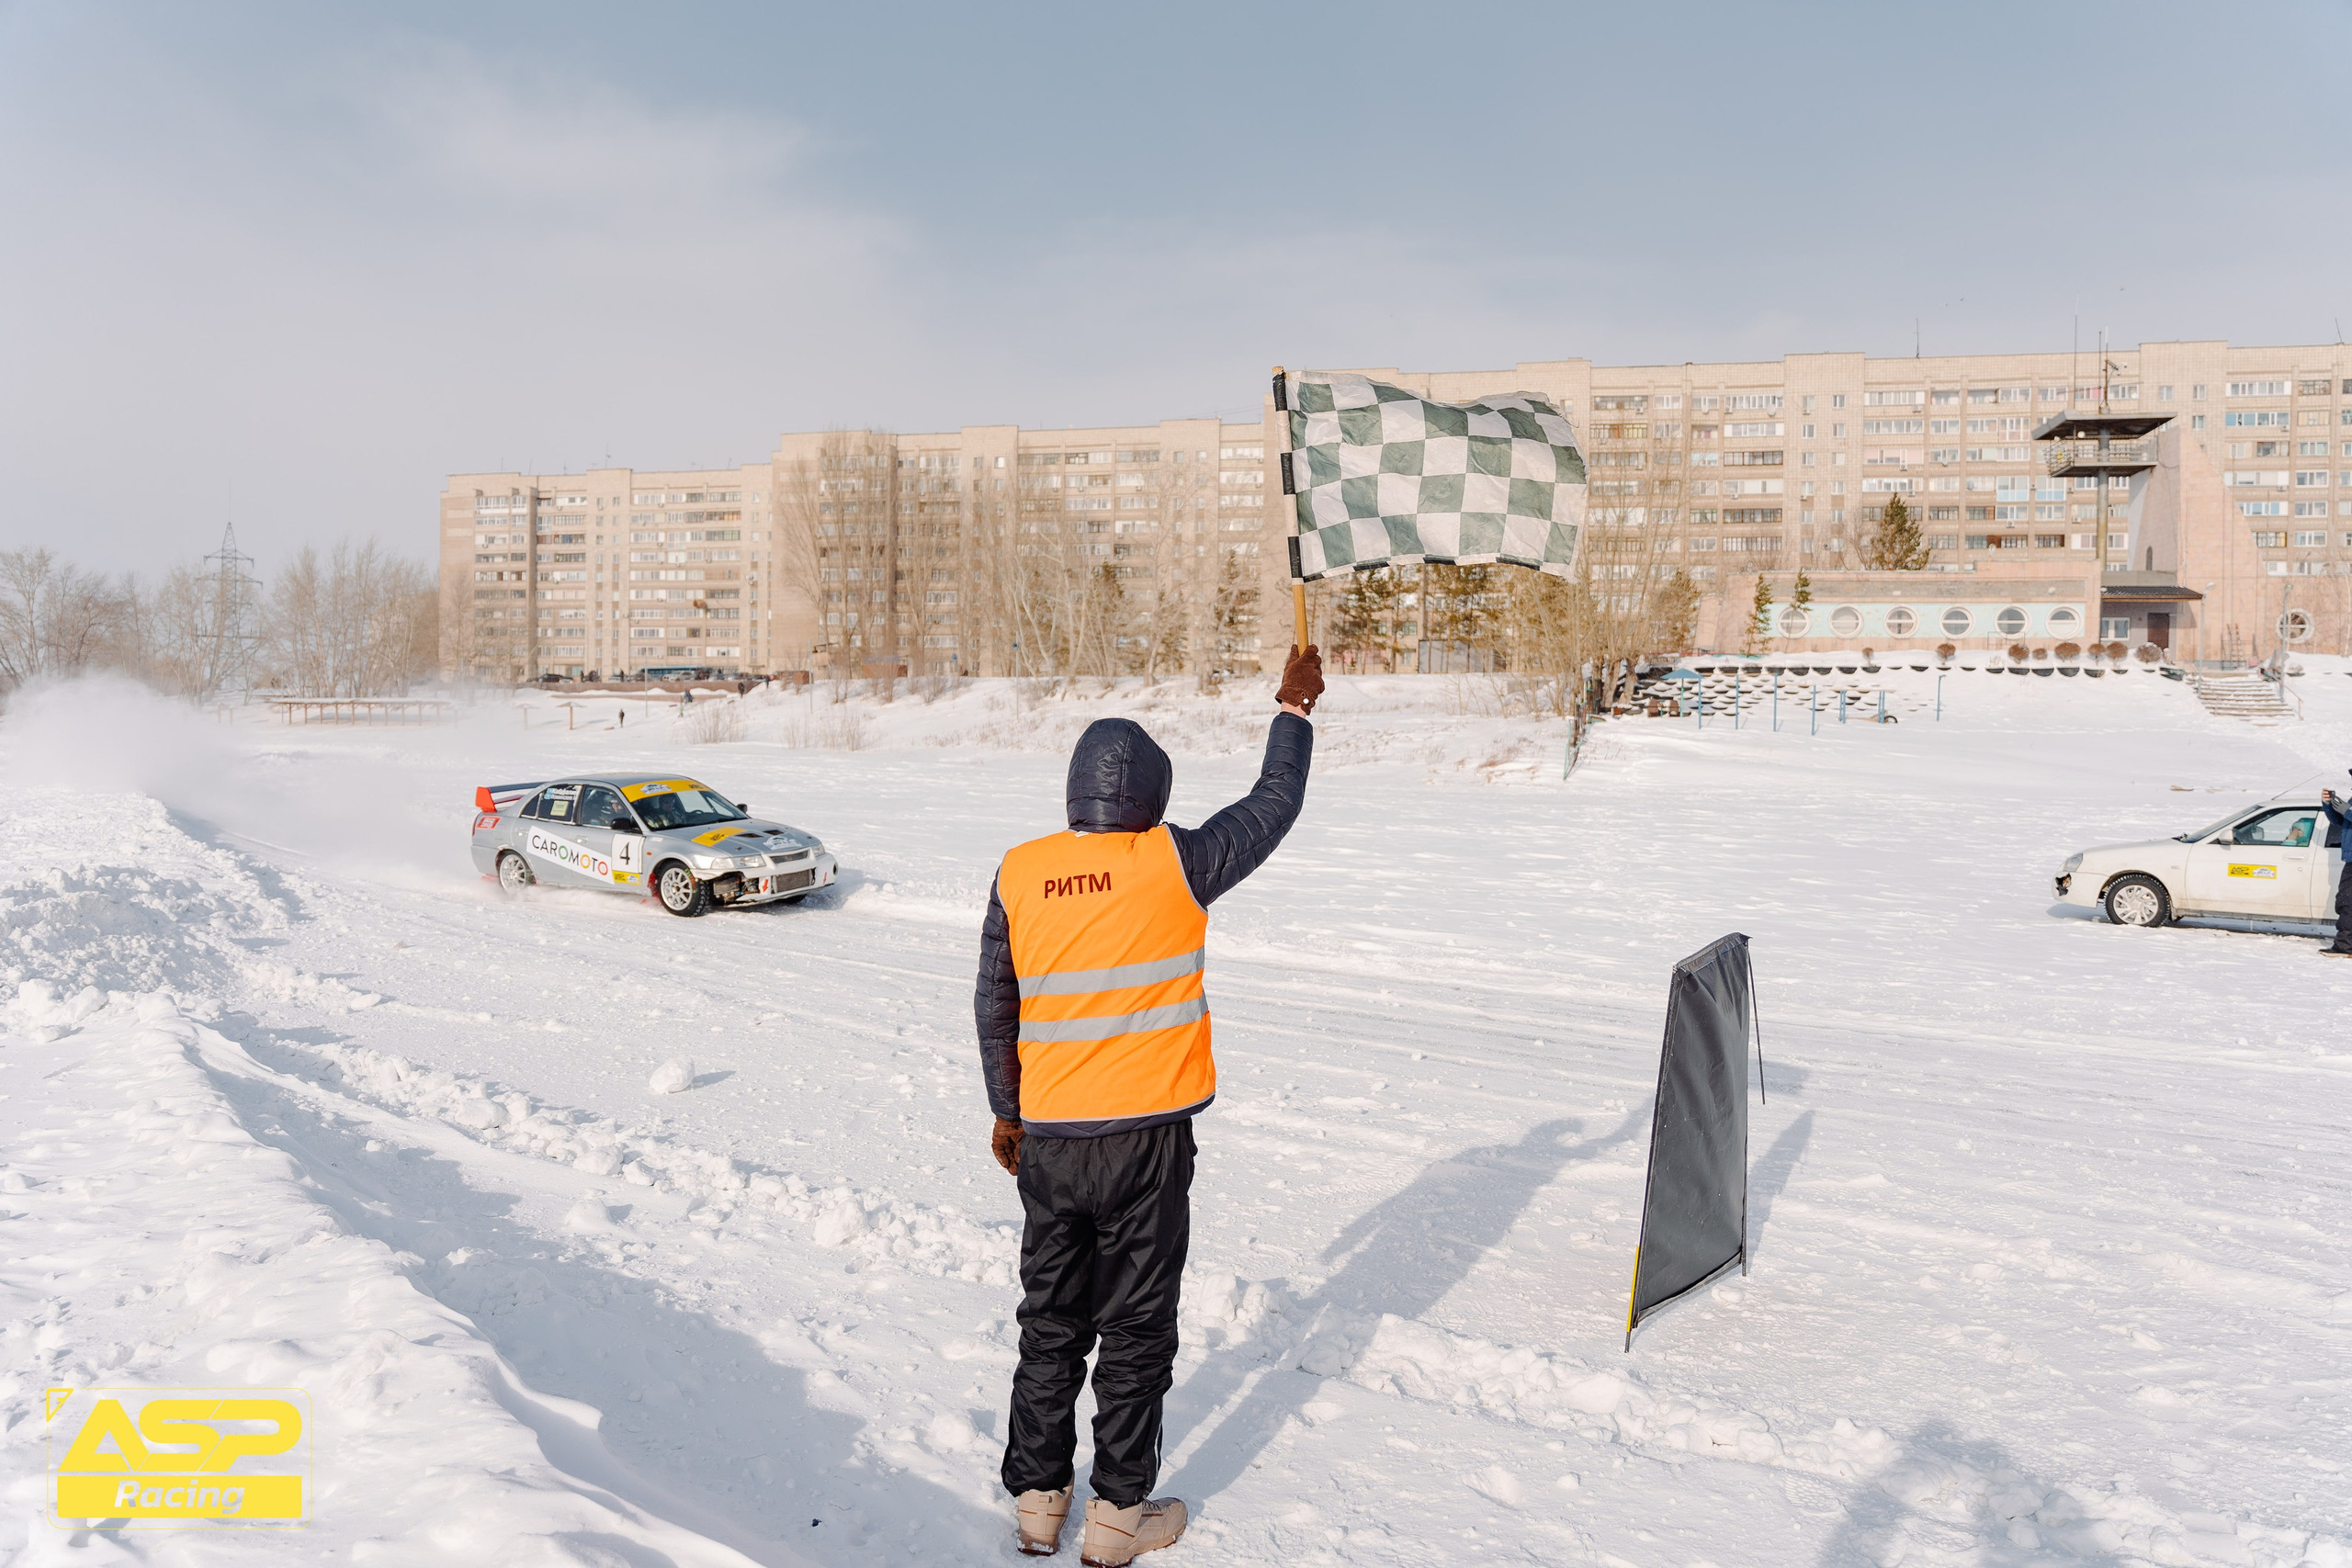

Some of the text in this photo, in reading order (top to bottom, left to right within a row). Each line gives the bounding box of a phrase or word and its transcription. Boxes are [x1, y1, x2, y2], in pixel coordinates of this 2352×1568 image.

[532, 835, 608, 875] CAROMOTO
[619, 841, 630, 865] 4
[1044, 872, 1112, 898] РИТМ
